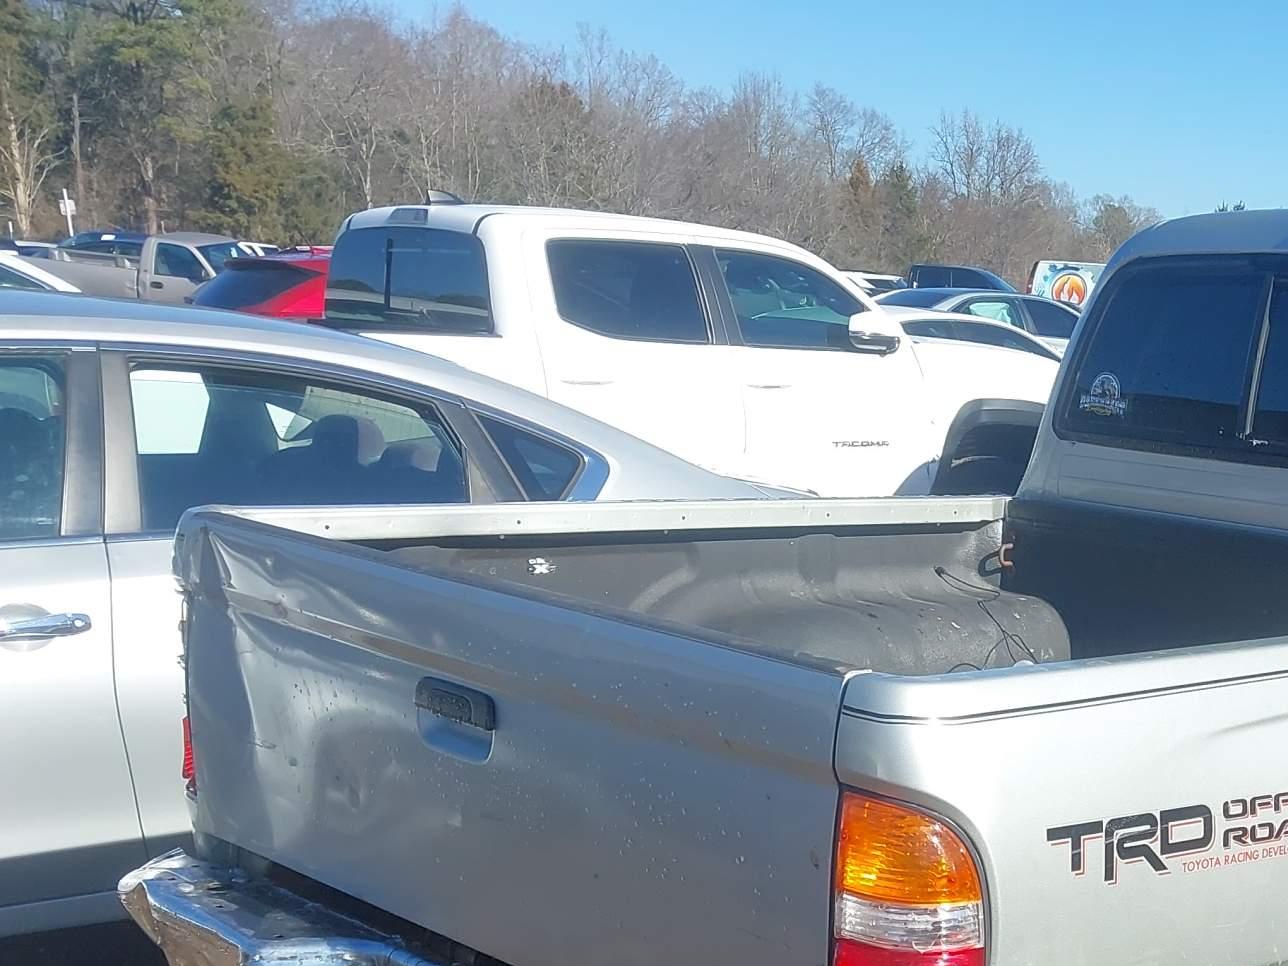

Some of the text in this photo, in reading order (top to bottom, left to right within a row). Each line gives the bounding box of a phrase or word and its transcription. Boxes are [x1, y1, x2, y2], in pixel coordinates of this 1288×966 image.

[1047, 804, 1214, 885] TRD
[1182, 857, 1221, 873] TOYOTA
[1224, 849, 1259, 865] RACING
